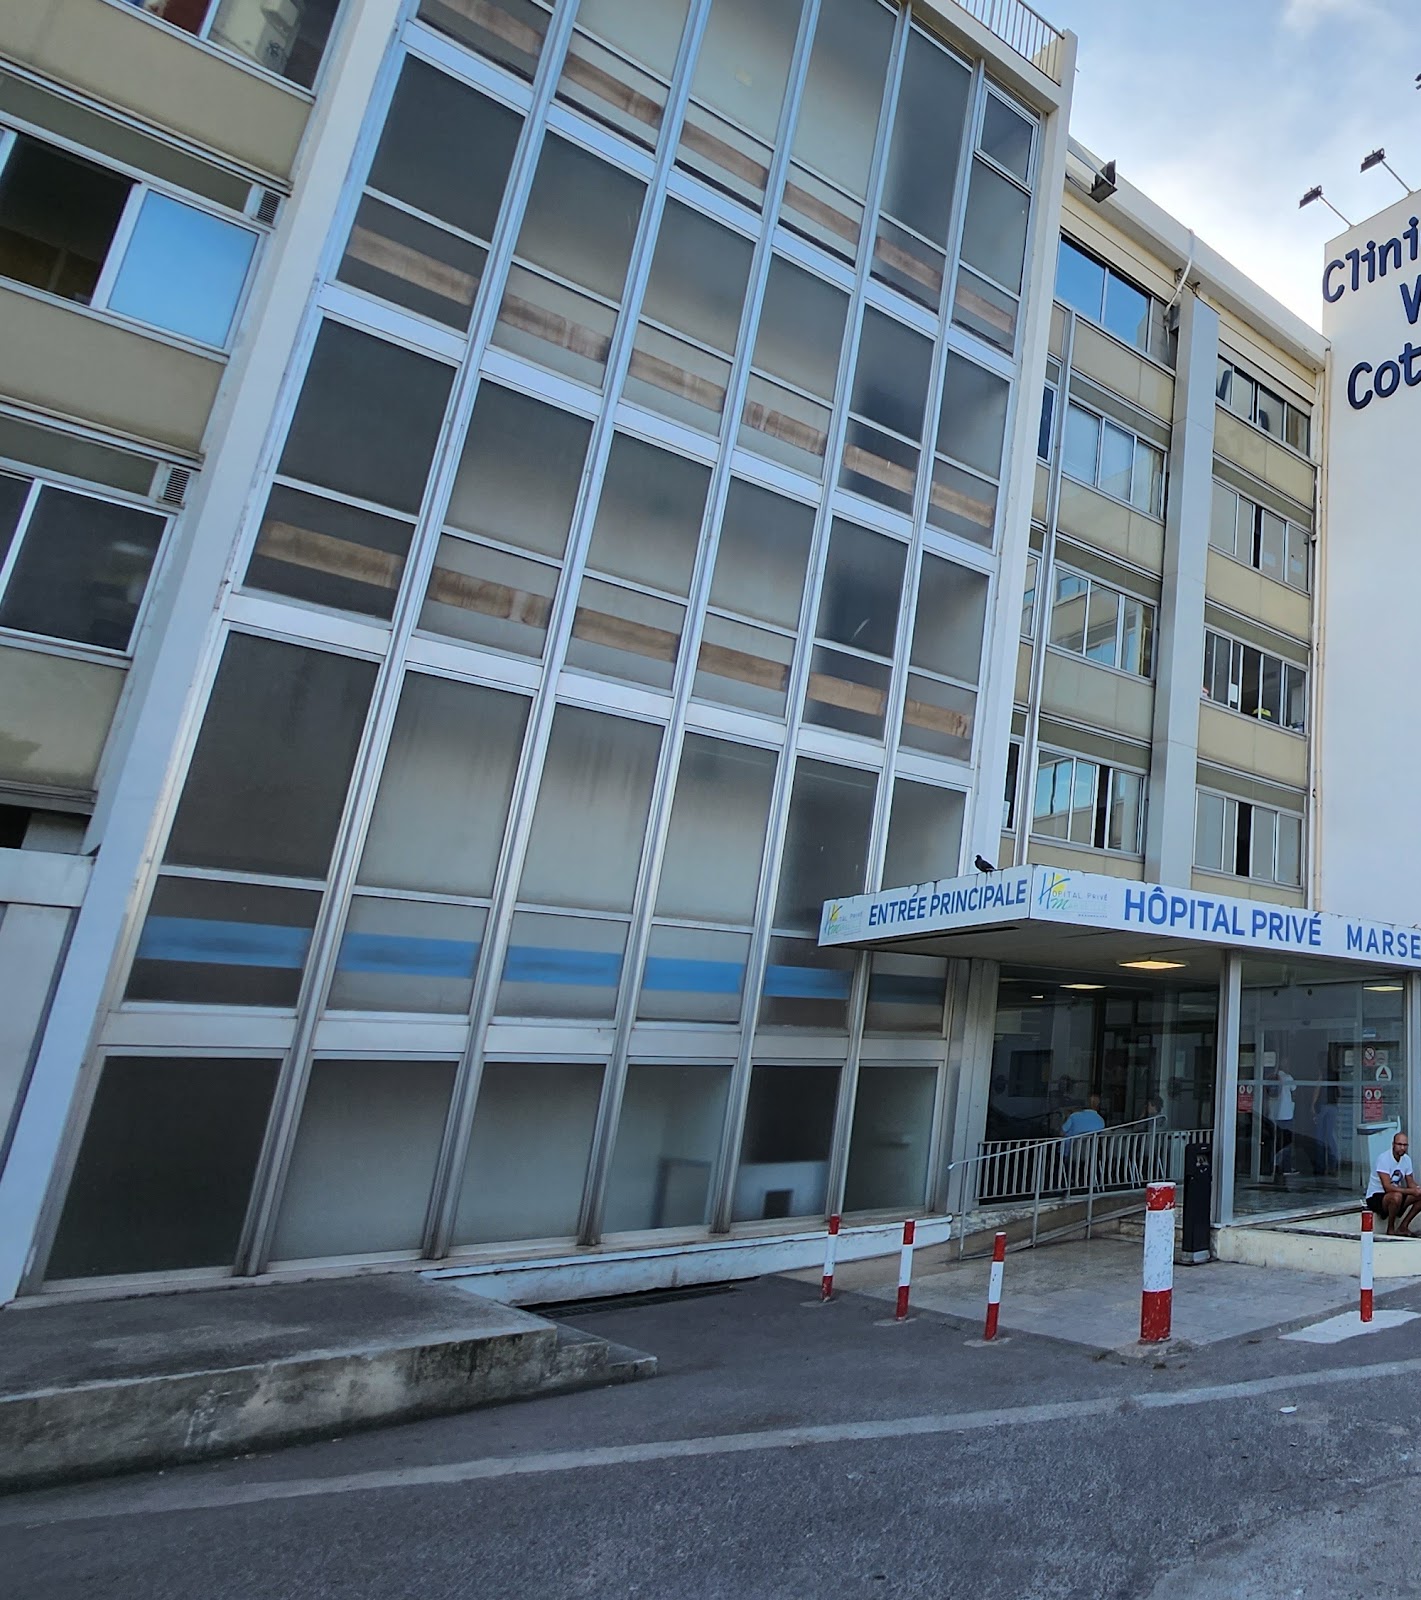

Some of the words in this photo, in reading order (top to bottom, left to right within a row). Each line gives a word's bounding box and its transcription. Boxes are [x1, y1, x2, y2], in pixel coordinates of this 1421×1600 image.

[868, 892, 927, 926] ENTRÉE
[929, 879, 1028, 918] PRINCIPALE
[1124, 886, 1246, 936] HÔPITAL
[1251, 909, 1322, 946] PRIVÉ
